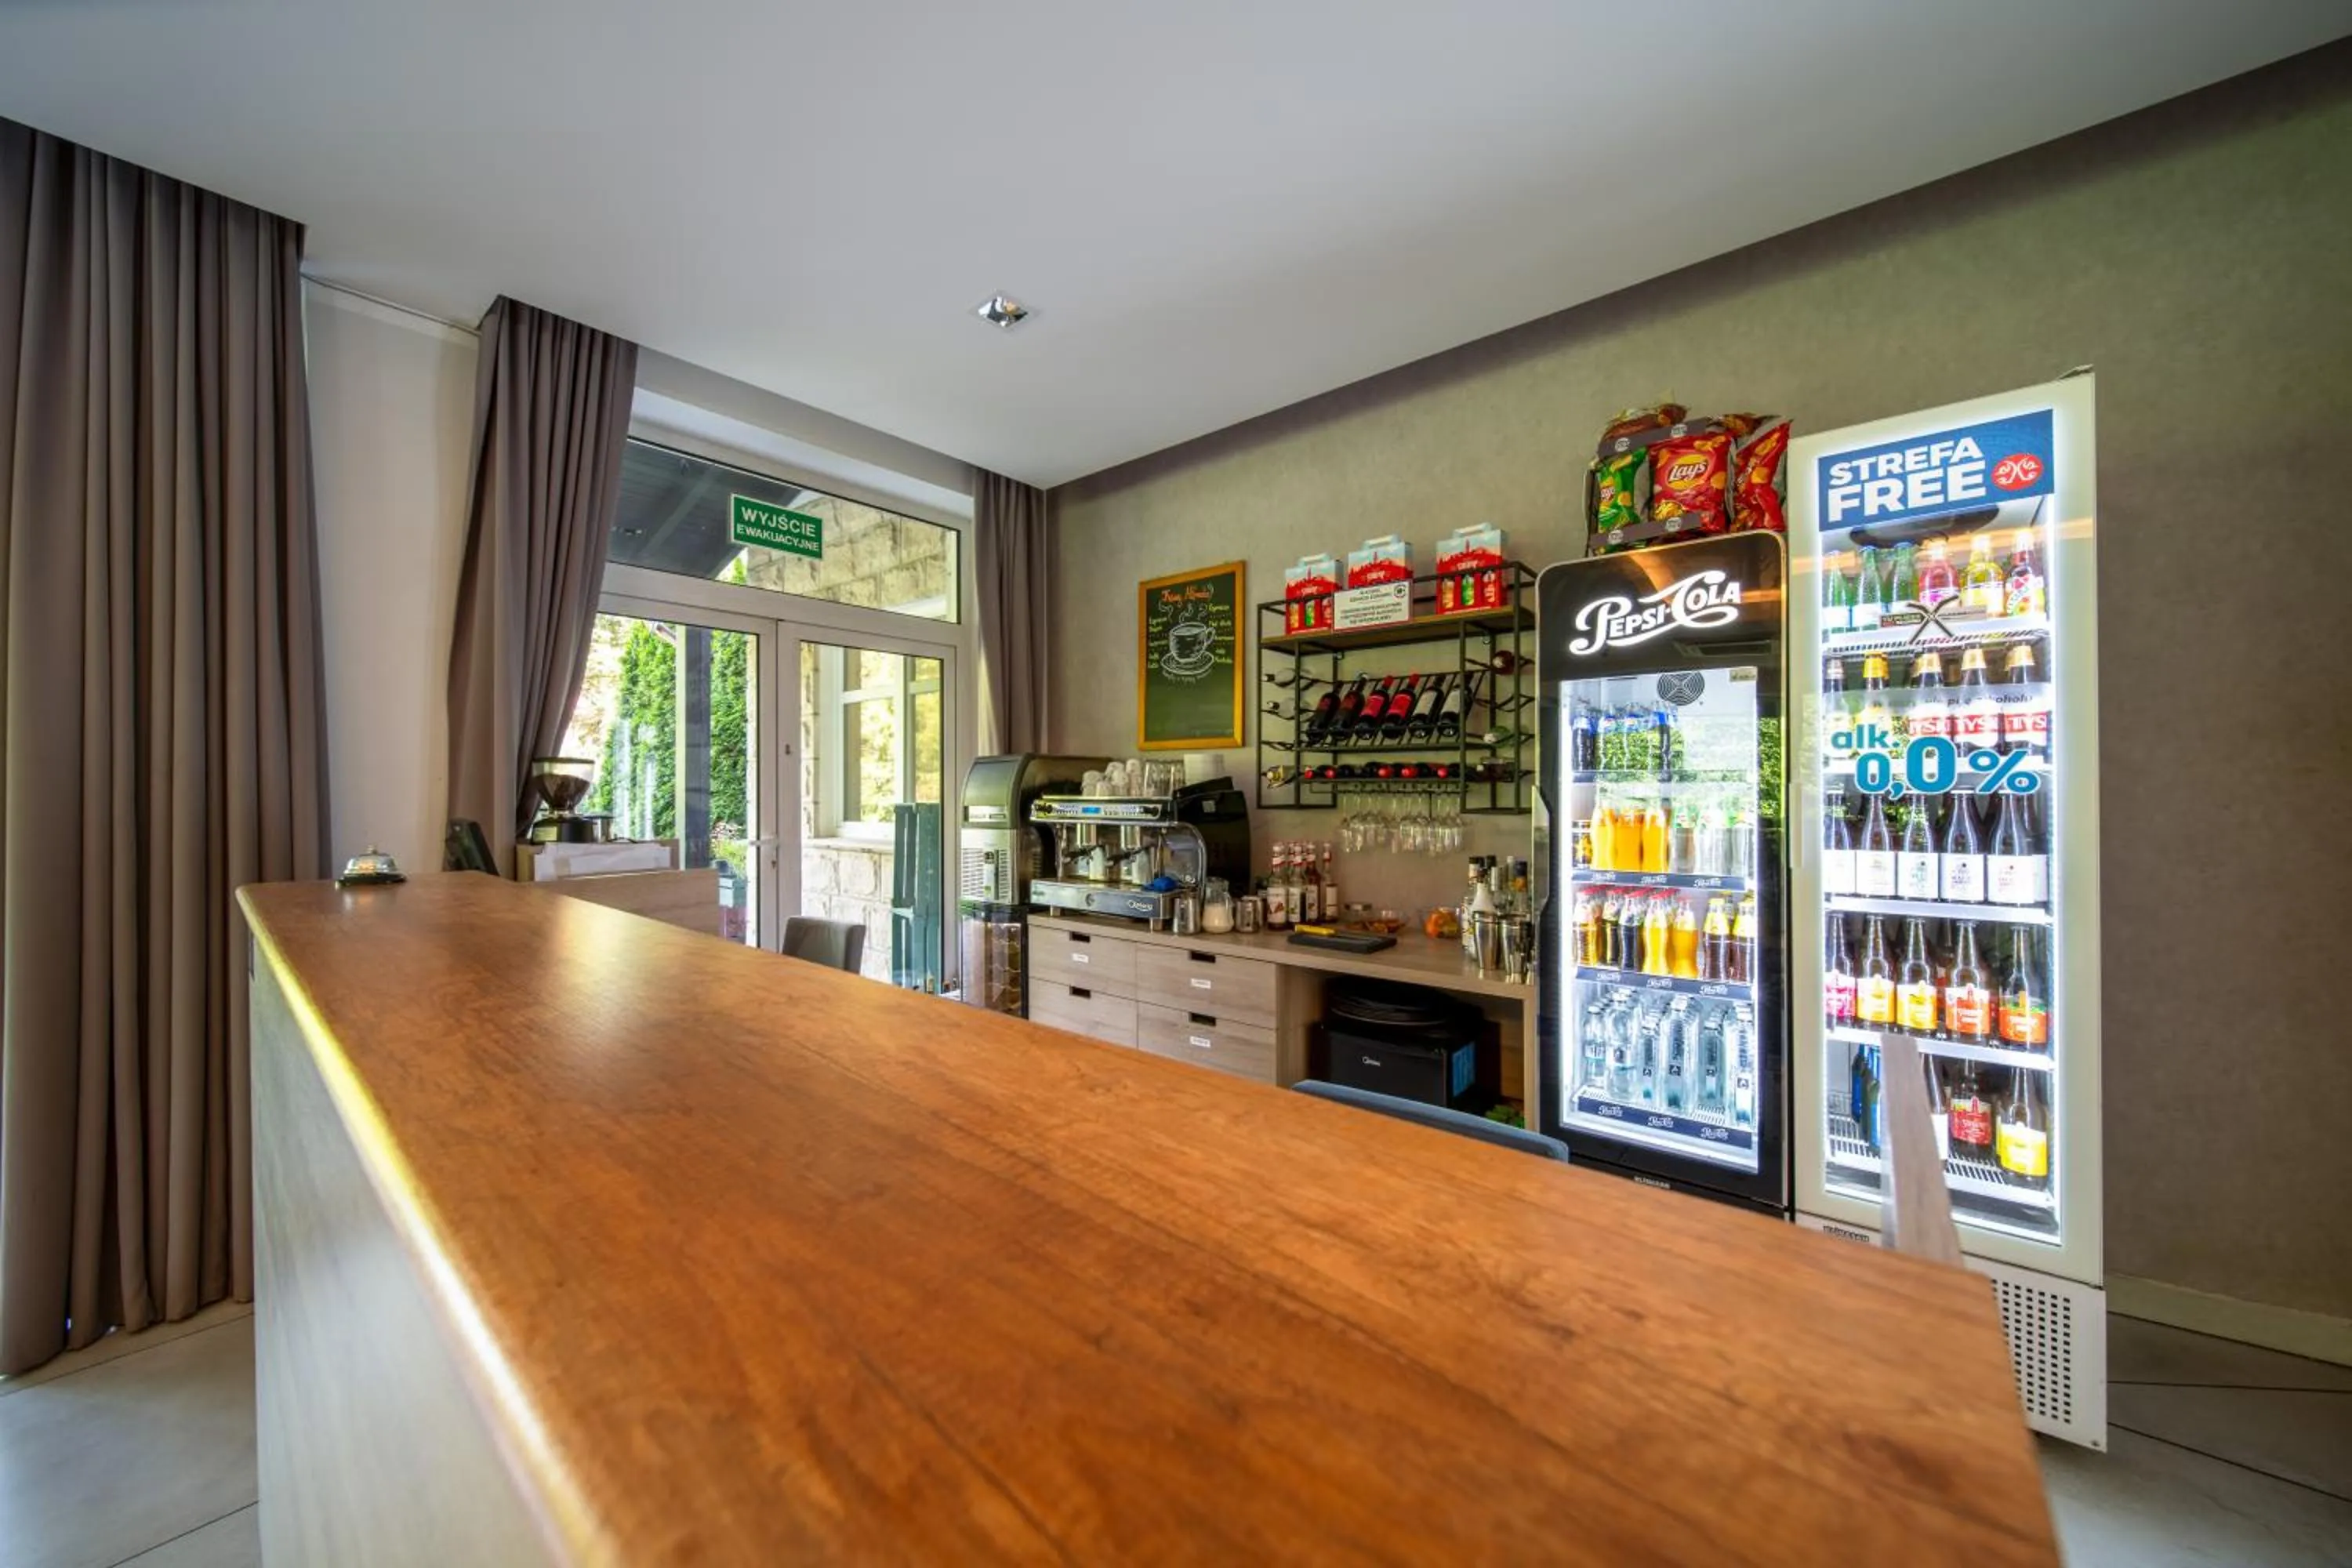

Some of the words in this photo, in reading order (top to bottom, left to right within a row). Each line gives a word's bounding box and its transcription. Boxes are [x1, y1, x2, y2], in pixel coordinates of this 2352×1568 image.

[1829, 437, 1984, 487] STREFA
[1828, 459, 1987, 523] FREE
[736, 523, 819, 552] EWAKUACYJNE
[741, 506, 816, 538] WYJŚCIE
[1831, 724, 1900, 750] alk.
